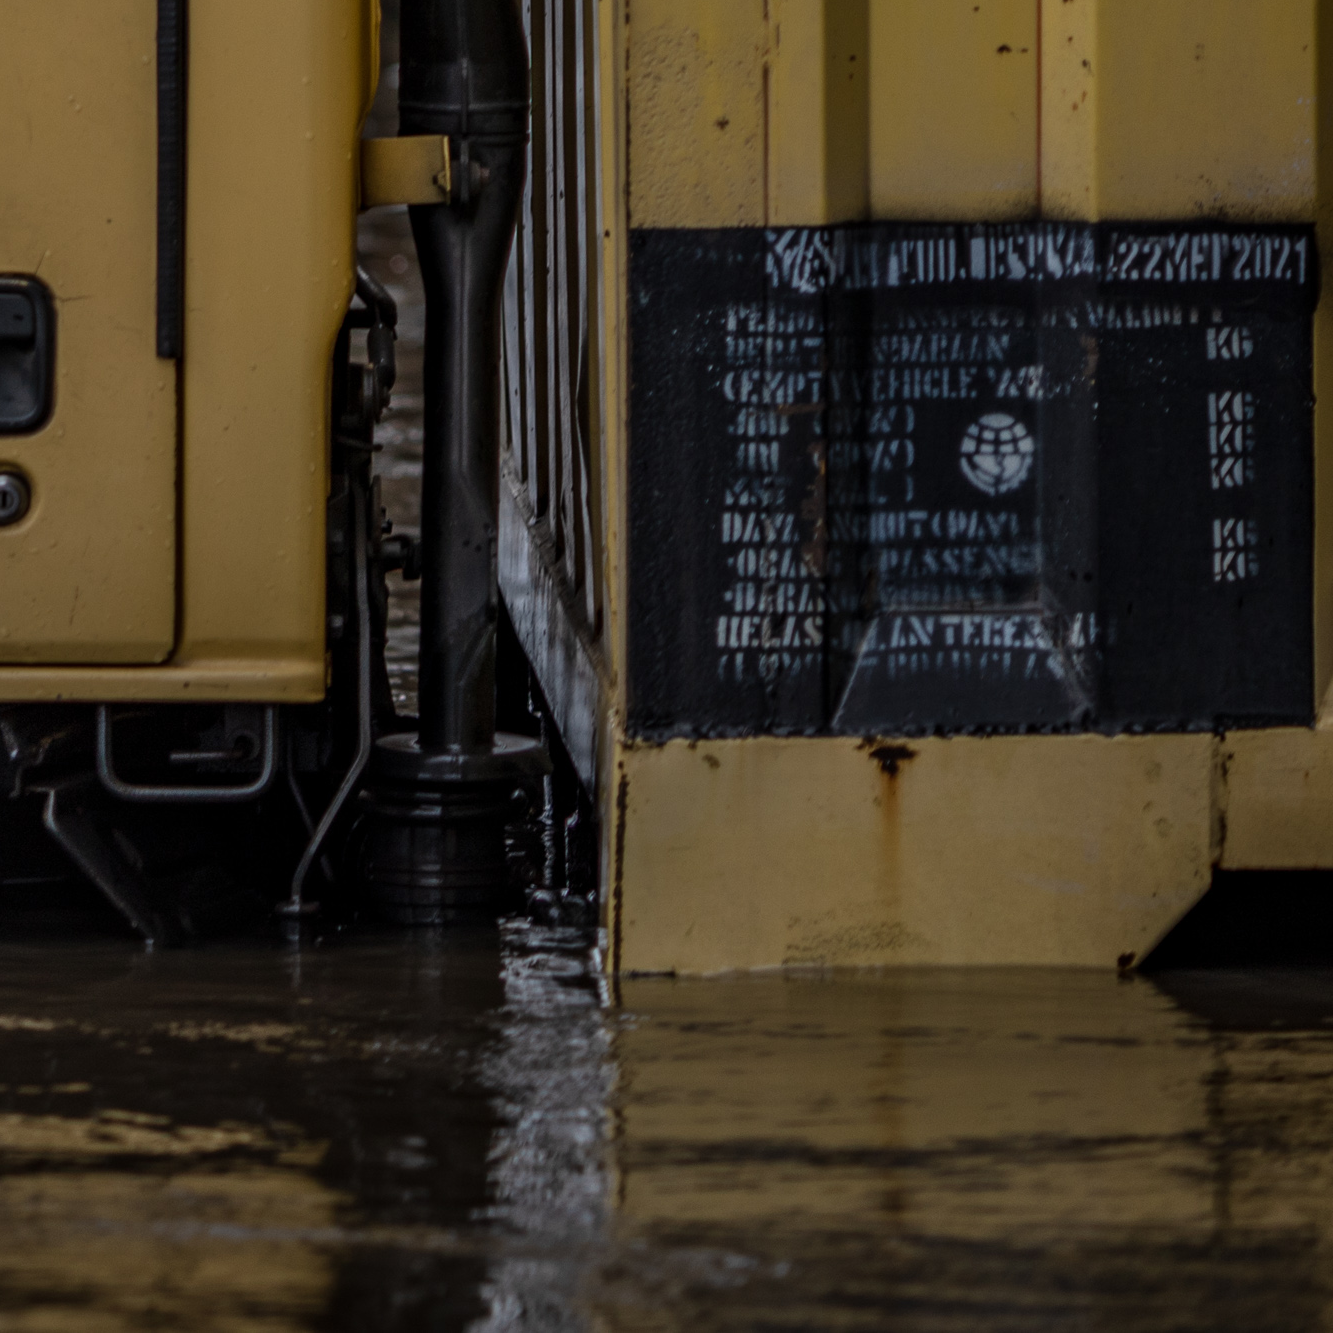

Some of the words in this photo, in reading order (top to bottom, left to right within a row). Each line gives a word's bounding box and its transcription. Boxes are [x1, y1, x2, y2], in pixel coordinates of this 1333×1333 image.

[1231, 234, 1309, 285] 2021
[1206, 326, 1254, 360] KG
[1207, 390, 1255, 424] KG
[1208, 423, 1255, 456] KG
[1210, 456, 1255, 491] KG
[1212, 517, 1258, 550] KG
[1213, 550, 1259, 583] KG
